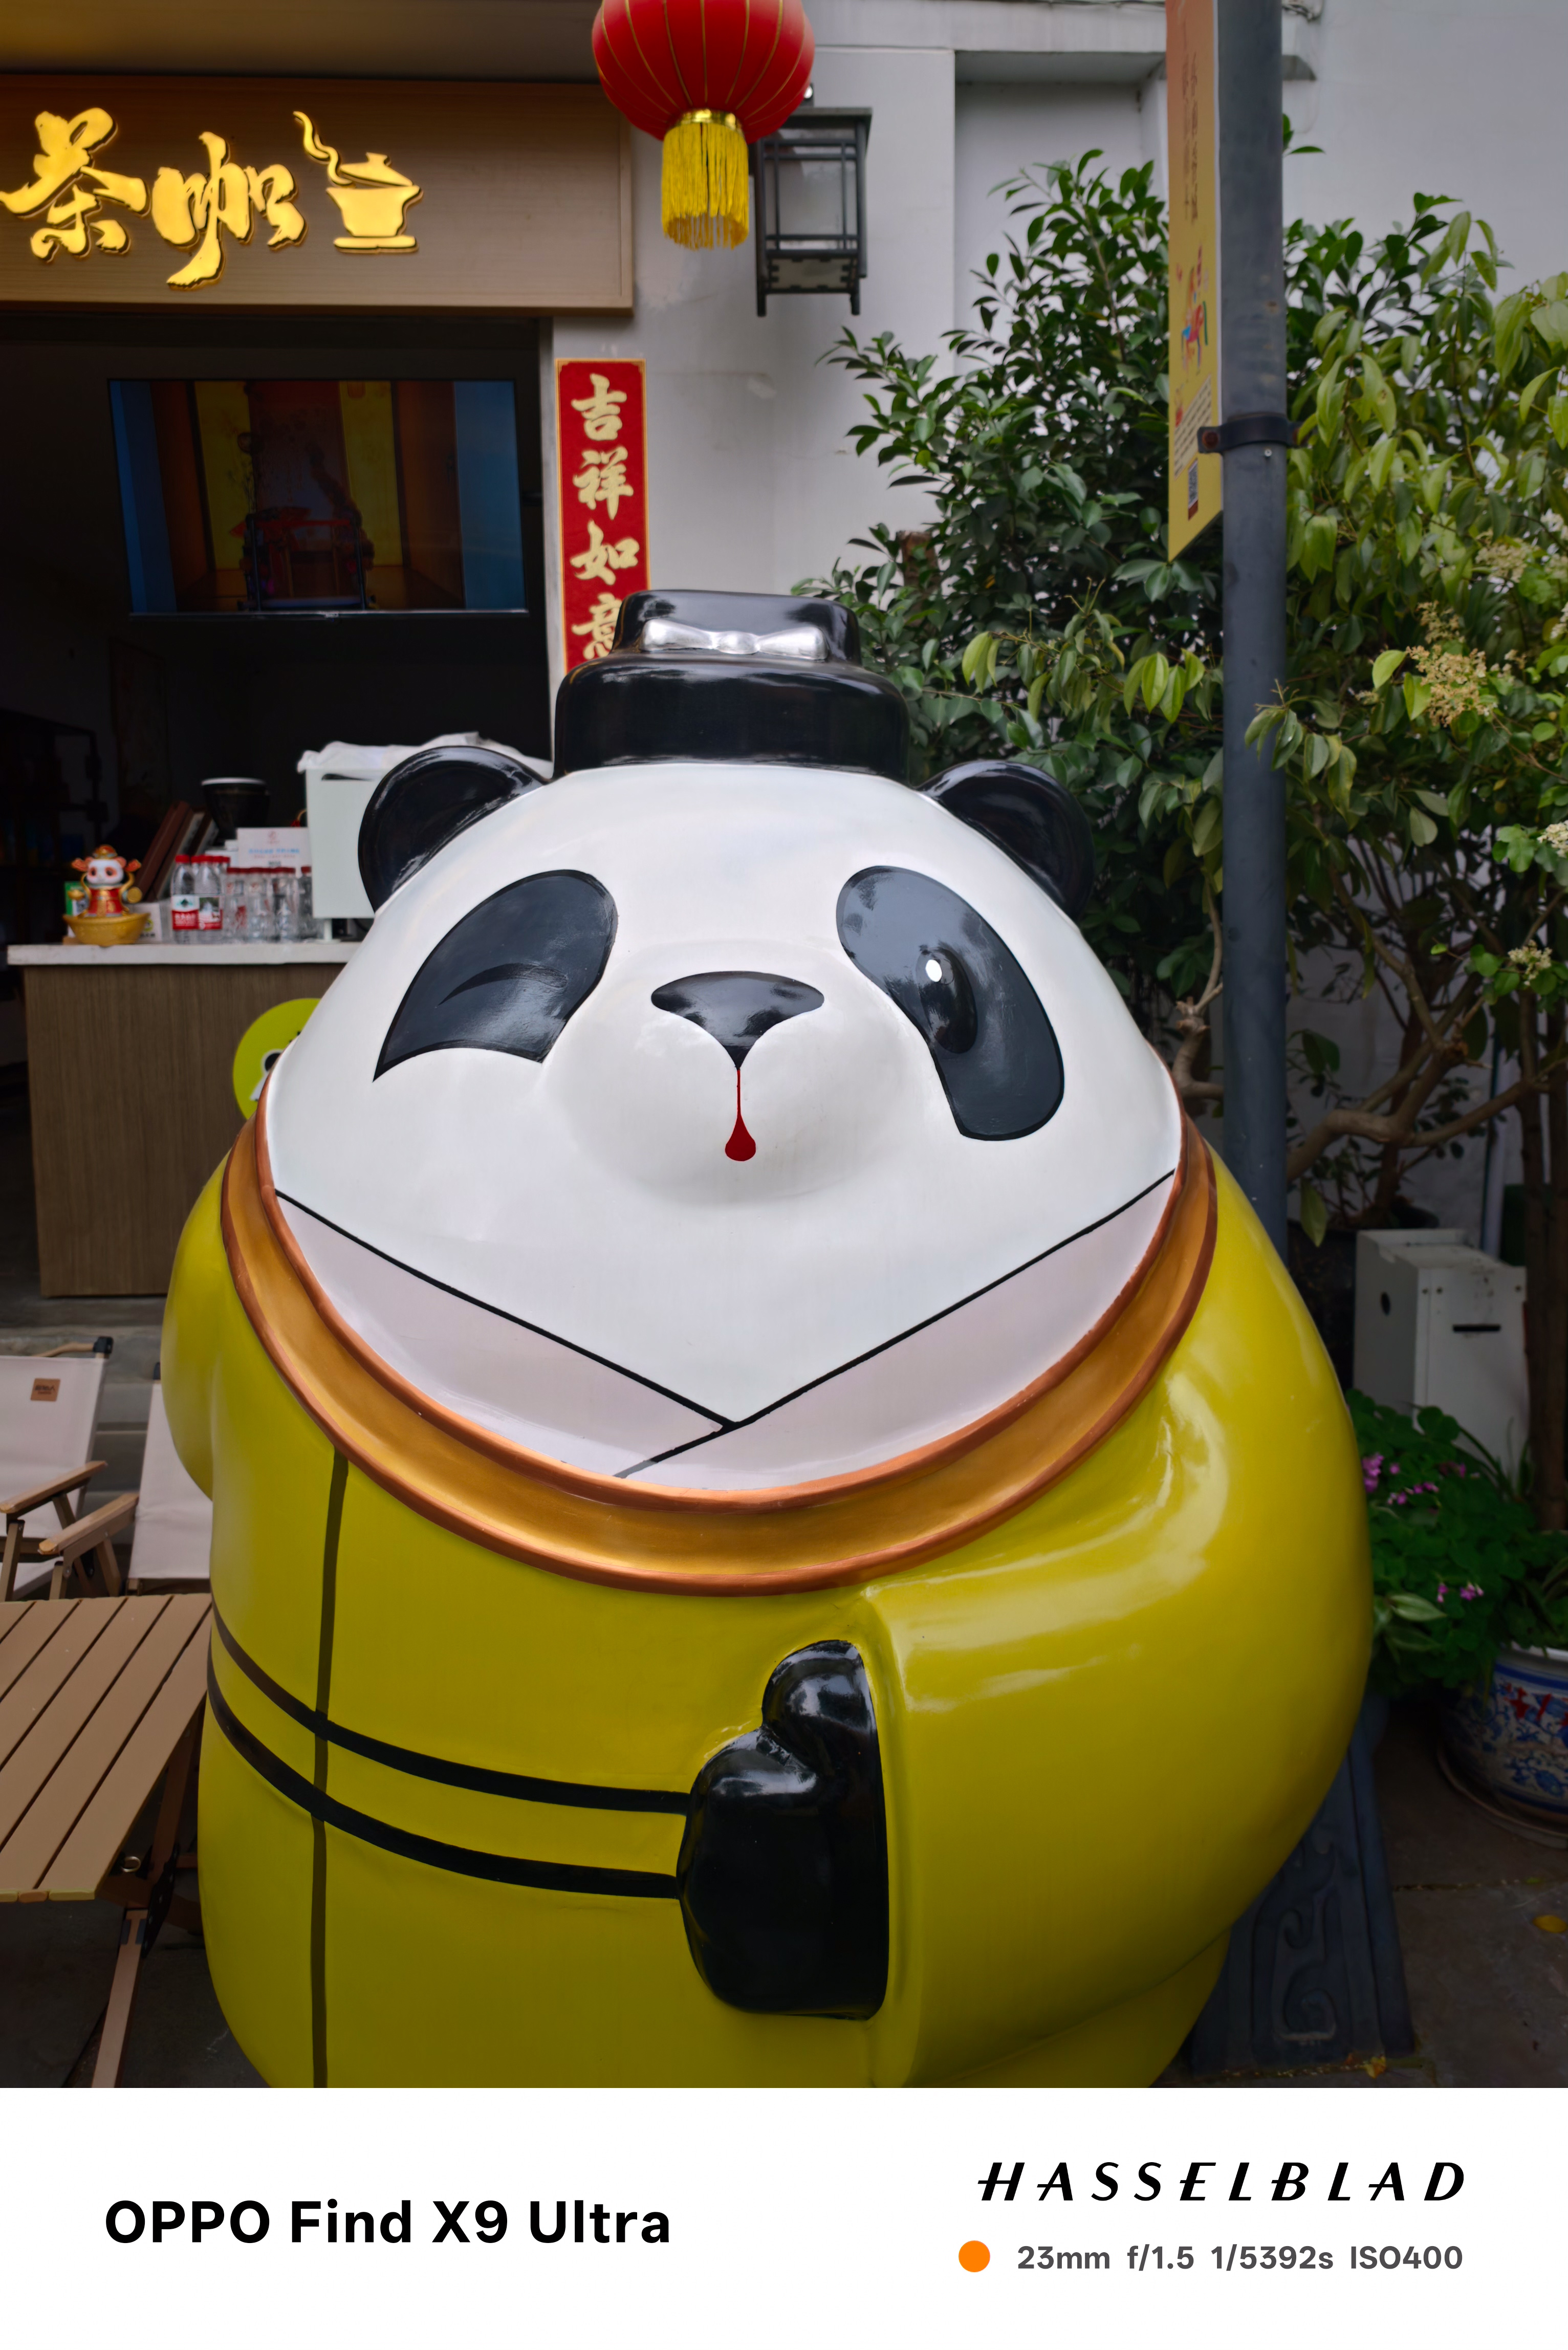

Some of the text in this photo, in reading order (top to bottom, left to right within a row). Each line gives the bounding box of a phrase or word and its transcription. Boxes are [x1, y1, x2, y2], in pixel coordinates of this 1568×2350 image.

[0, 107, 307, 288] 茶咖
[570, 374, 640, 660] 吉祥如意
